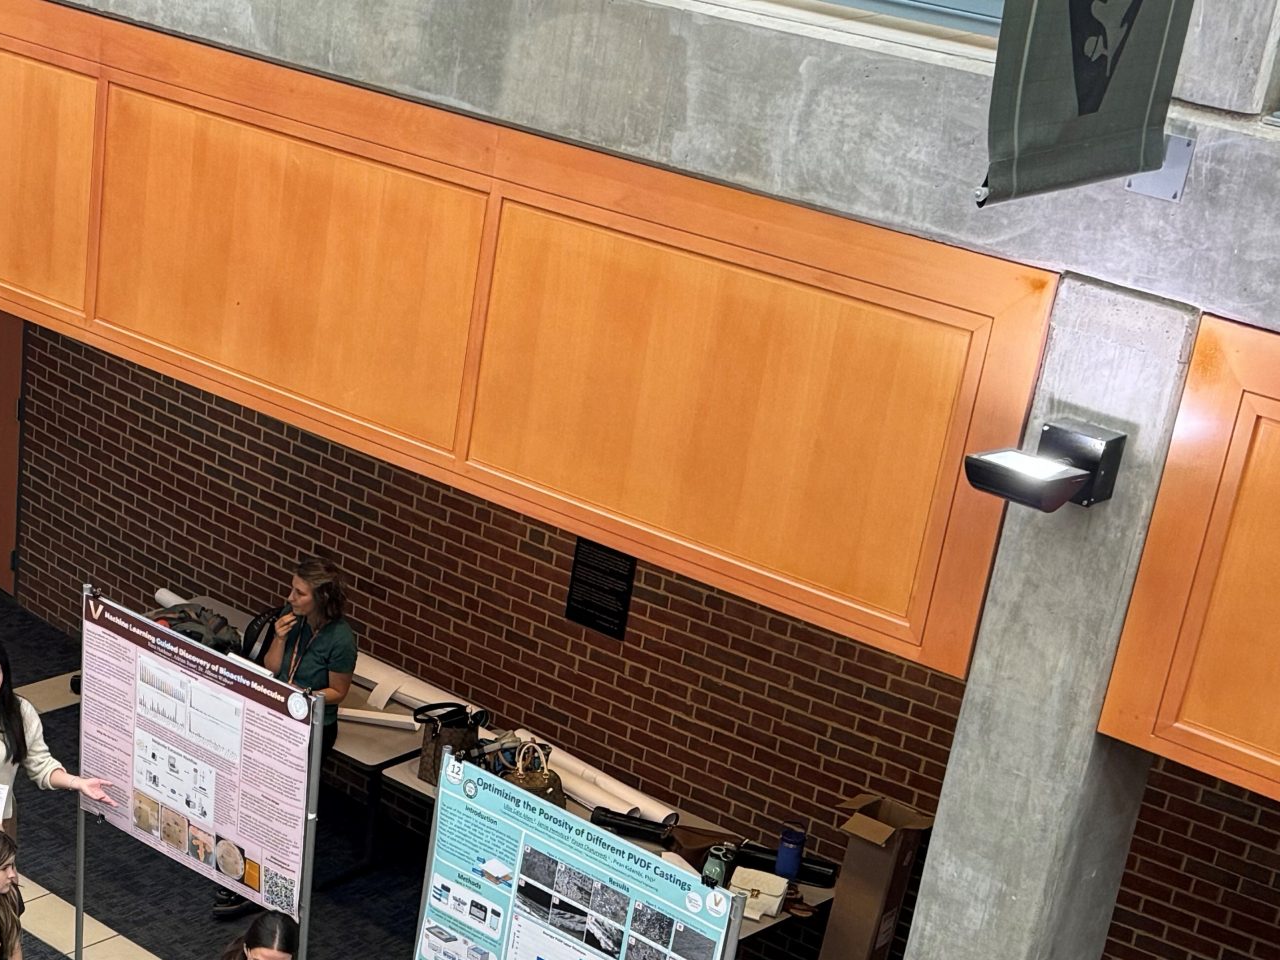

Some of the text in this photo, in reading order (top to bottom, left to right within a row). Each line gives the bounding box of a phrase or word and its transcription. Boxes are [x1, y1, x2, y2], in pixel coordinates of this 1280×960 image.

[104, 611, 129, 630] Machine
[129, 624, 156, 644] Learning
[156, 637, 179, 654] Guided
[179, 647, 211, 670] Discovery
[211, 662, 219, 672] of
[218, 666, 250, 687] Bioactive
[250, 680, 285, 702] Molecules
[450, 764, 461, 774] 12
[464, 804, 498, 826] Introduction
[476, 777, 692, 892] Optimizing the Porosity of Different PVDF Castings
[457, 872, 482, 890] Methods
[608, 876, 630, 893] Results
